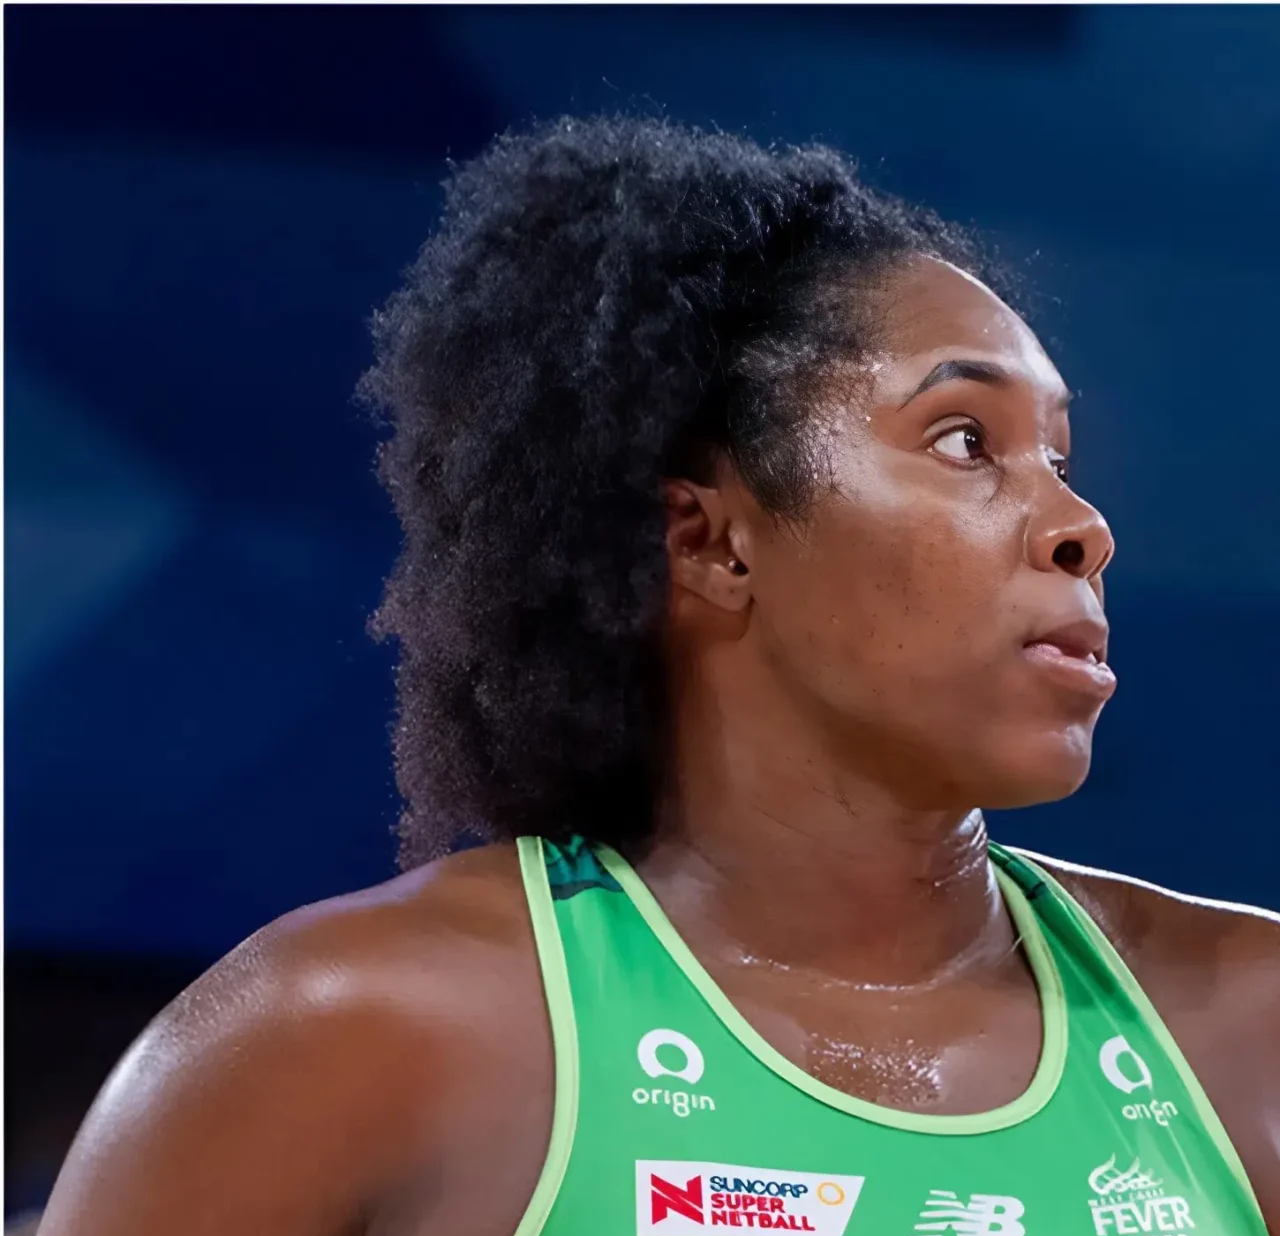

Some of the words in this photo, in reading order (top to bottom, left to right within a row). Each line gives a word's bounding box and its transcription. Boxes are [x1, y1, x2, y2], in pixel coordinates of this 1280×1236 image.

[632, 1088, 716, 1117] origin
[709, 1175, 808, 1198] SUNCORP
[711, 1193, 786, 1214] SUPER
[711, 1210, 816, 1231] NETBALL
[1091, 1196, 1195, 1236] FEVER
